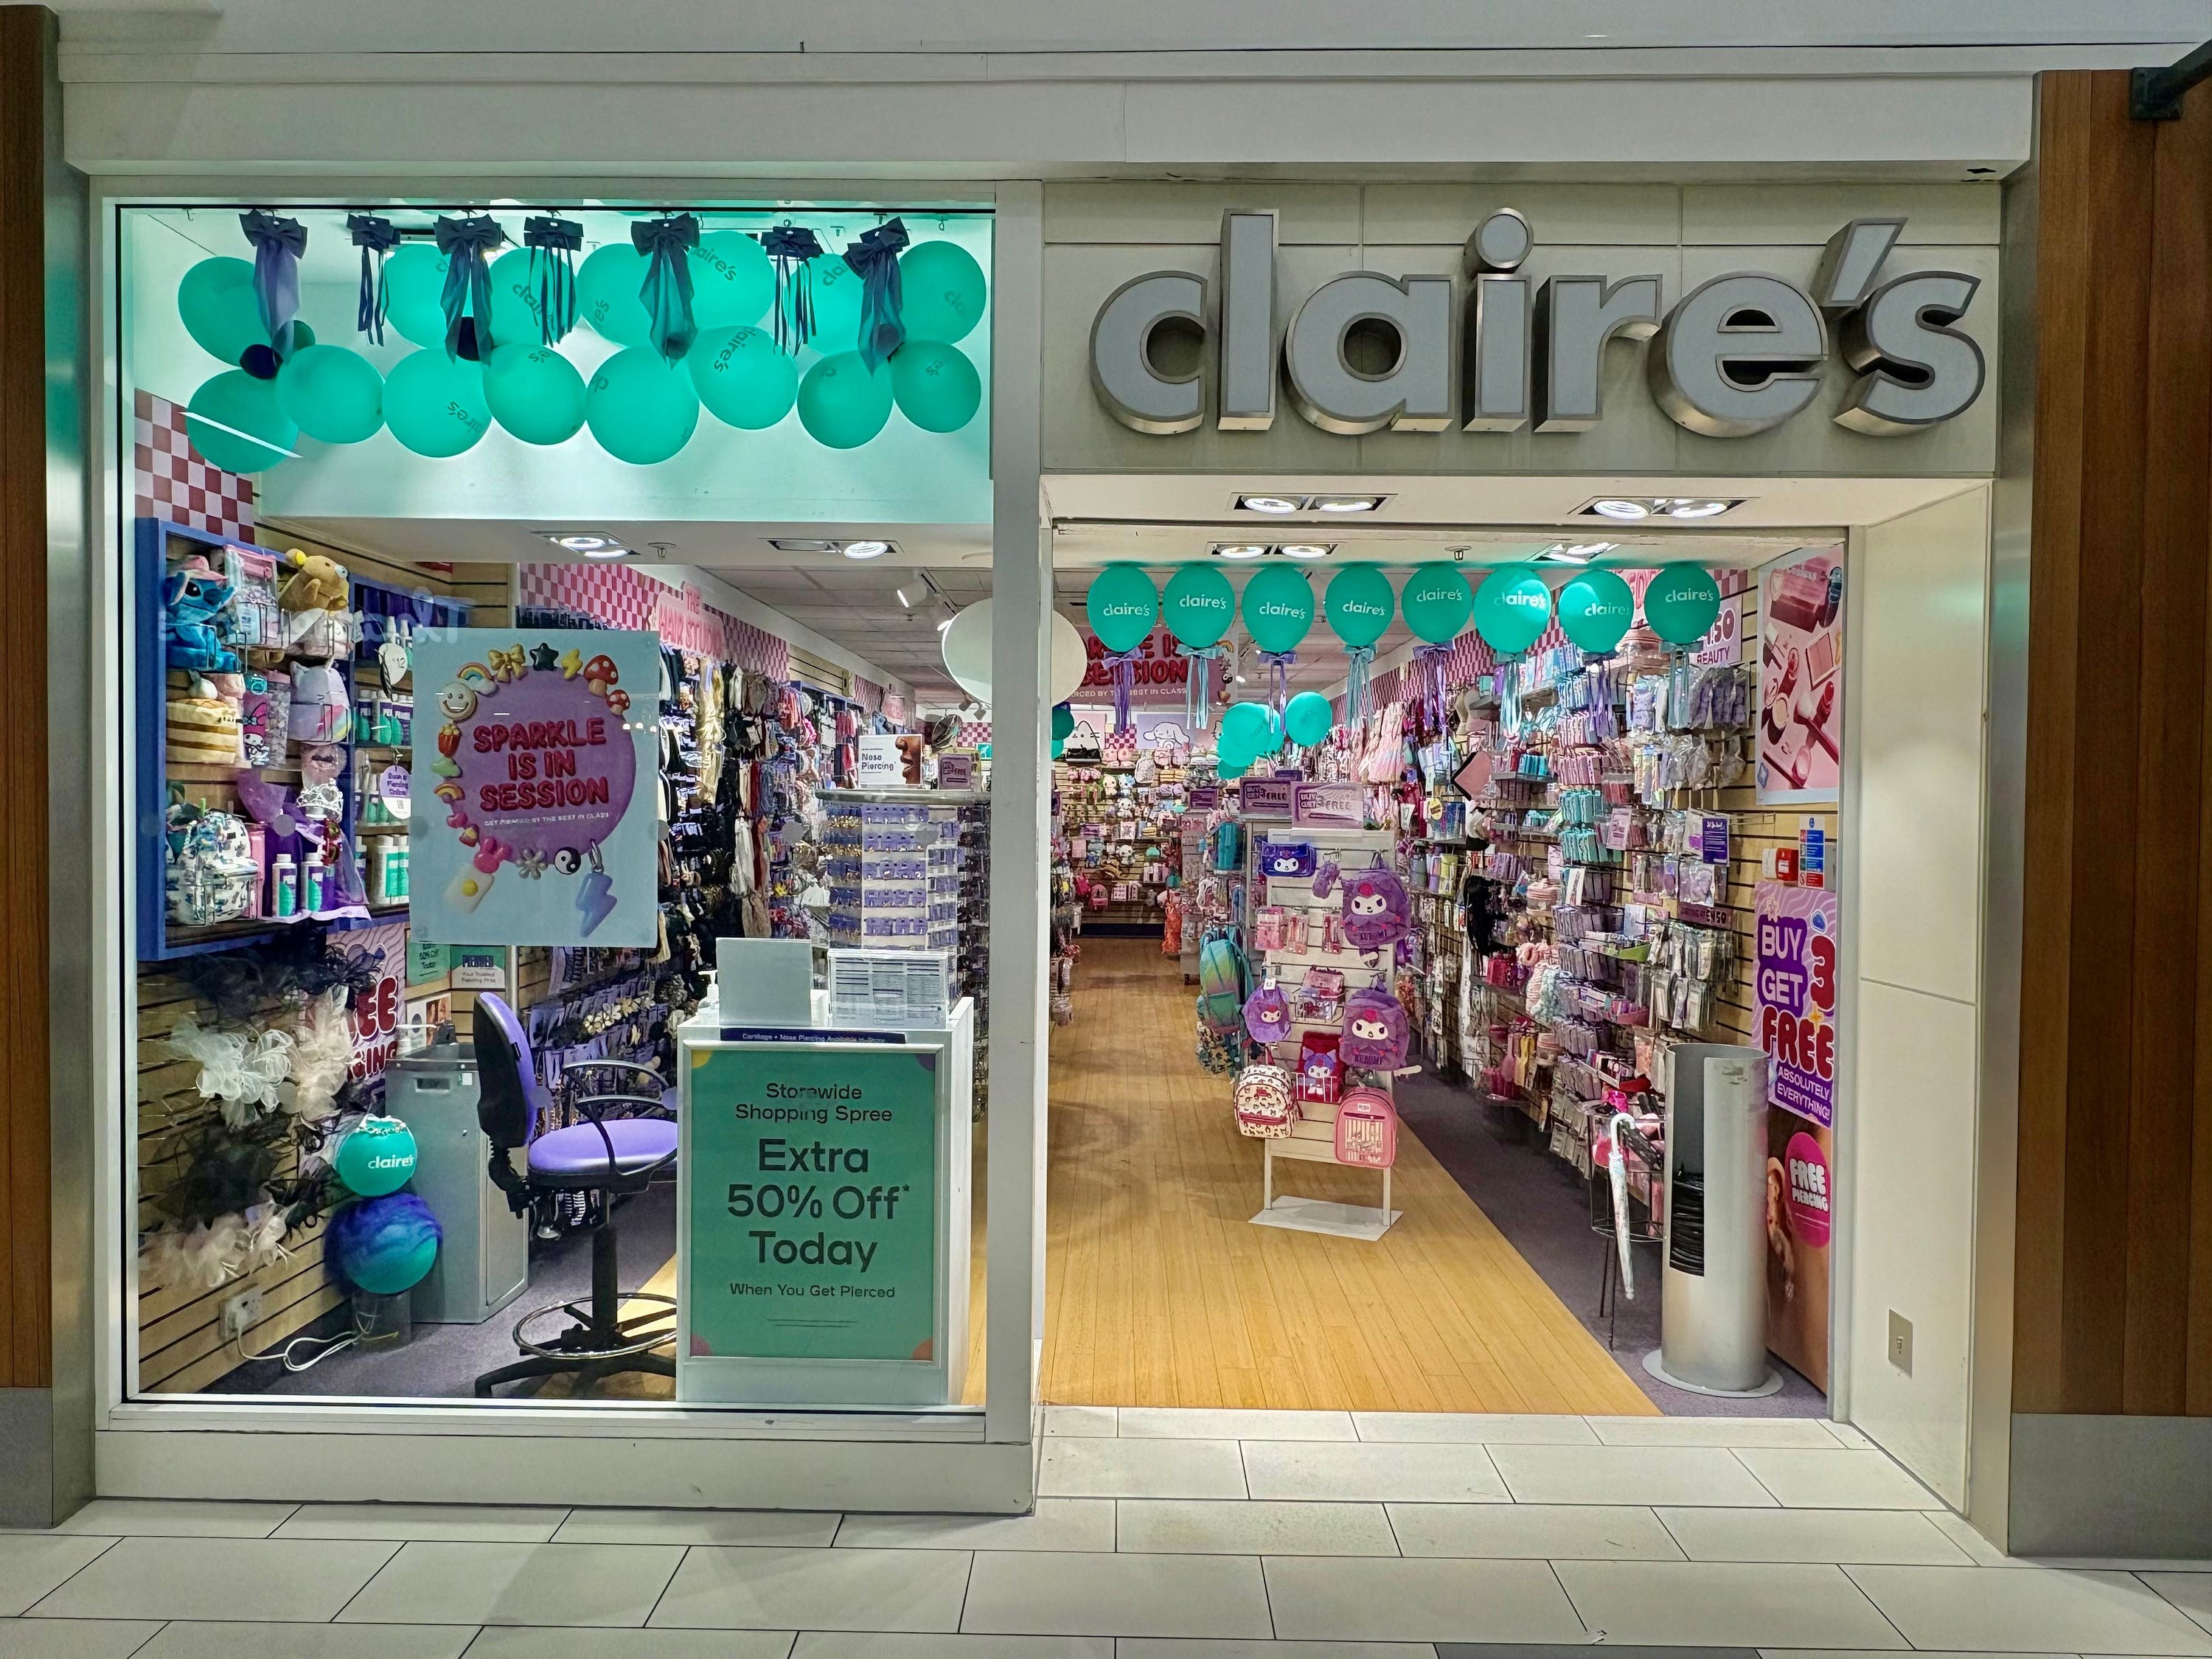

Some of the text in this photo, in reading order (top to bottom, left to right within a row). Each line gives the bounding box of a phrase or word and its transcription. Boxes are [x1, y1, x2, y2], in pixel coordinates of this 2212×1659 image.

[1090, 207, 1985, 437] claire's
[686, 591, 700, 614] THE
[1180, 594, 1226, 609] claire's
[1416, 588, 1462, 602] claire's
[1494, 590, 1546, 609] claire's
[1665, 588, 1714, 602] claire's
[1103, 602, 1150, 616] claire's
[1259, 602, 1306, 619] claire's
[1343, 600, 1385, 616] claire's
[1585, 602, 1630, 616] claire's
[659, 604, 684, 645] HAIR
[1697, 646, 1730, 664] BEAUTY
[473, 717, 606, 753] SPARKLE
[508, 749, 576, 780] IS IN
[861, 753, 883, 761] Nose
[480, 776, 609, 812] SESSION
[1266, 793, 1287, 801] FREE
[1326, 800, 1352, 810] FREE
[1762, 925, 1802, 961] BUY
[1762, 935, 1835, 1011] GET 3
[1762, 1005, 1834, 1081] FREE
[766, 1082, 862, 1099] Storewide
[1778, 1065, 1831, 1099] ABSOLUTELY
[1777, 1082, 1831, 1121] EVERYTHING!
[736, 1103, 893, 1124] Shopping Spree
[368, 1154, 414, 1170] claire's
[759, 1138, 869, 1173] Extra
[1789, 1158, 1826, 1196] FREE
[728, 1183, 823, 1219] 50%
[1792, 1186, 1829, 1213] PIERCING
[748, 1230, 878, 1273] Today
[730, 1282, 895, 1298] When You Get Pierced
